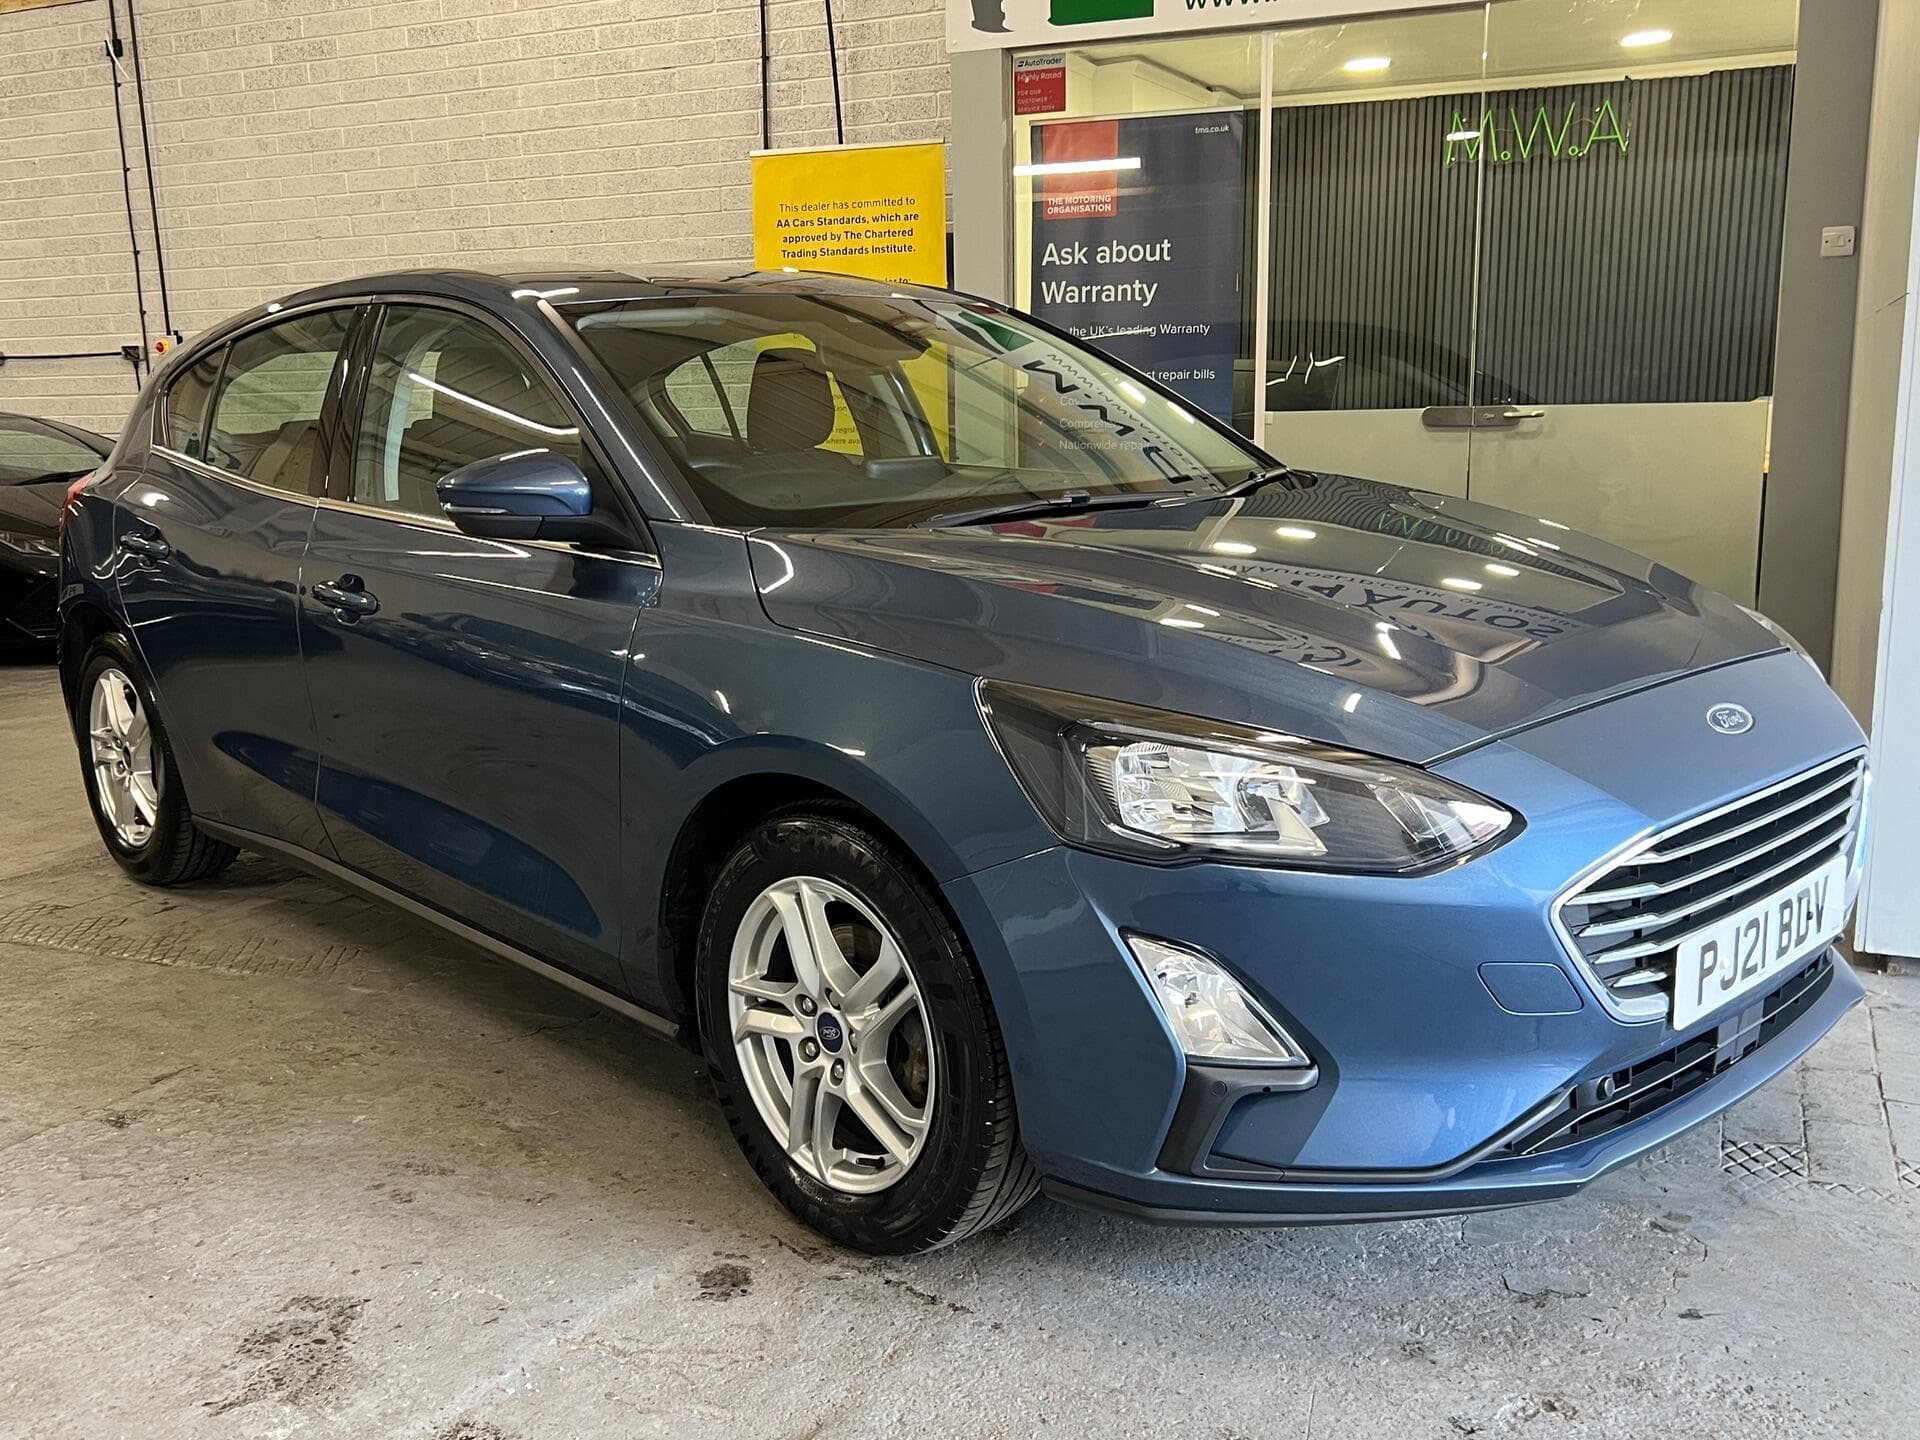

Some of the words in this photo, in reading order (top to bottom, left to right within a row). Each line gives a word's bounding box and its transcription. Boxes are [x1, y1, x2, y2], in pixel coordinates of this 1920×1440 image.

[1024, 57, 1062, 67] AutoTrader
[1040, 71, 1062, 80] Rated
[779, 203, 798, 213] This
[801, 202, 830, 212] dealer
[833, 200, 849, 210] has
[851, 197, 903, 208] committed
[905, 196, 916, 206] to
[1047, 198, 1064, 206] THE
[1065, 195, 1112, 205] MOTORING
[1047, 204, 1112, 215] ORGANISATION
[776, 218, 790, 229] AA
[793, 217, 815, 228] Cars
[817, 215, 870, 226] Standards,
[871, 213, 902, 223] which
[903, 212, 920, 221] are
[783, 232, 828, 244] approved
[830, 231, 842, 242] by
[844, 230, 862, 240] The
[864, 228, 914, 240] Chartered
[781, 248, 817, 259] Trading
[819, 245, 869, 257] Standards
[871, 243, 916, 255] Institute.
[1041, 242, 1089, 266] Ask
[1096, 239, 1172, 264] about
[1041, 280, 1158, 307] Warranty
[1069, 327, 1087, 338] the
[1090, 325, 1114, 337] UK's
[1116, 323, 1157, 338] leading
[1160, 324, 1211, 337] Warranty
[1158, 370, 1190, 384] repair
[1193, 369, 1216, 380] bills
[1697, 910, 1769, 1007] PJ21
[1775, 874, 1829, 961] BDV
